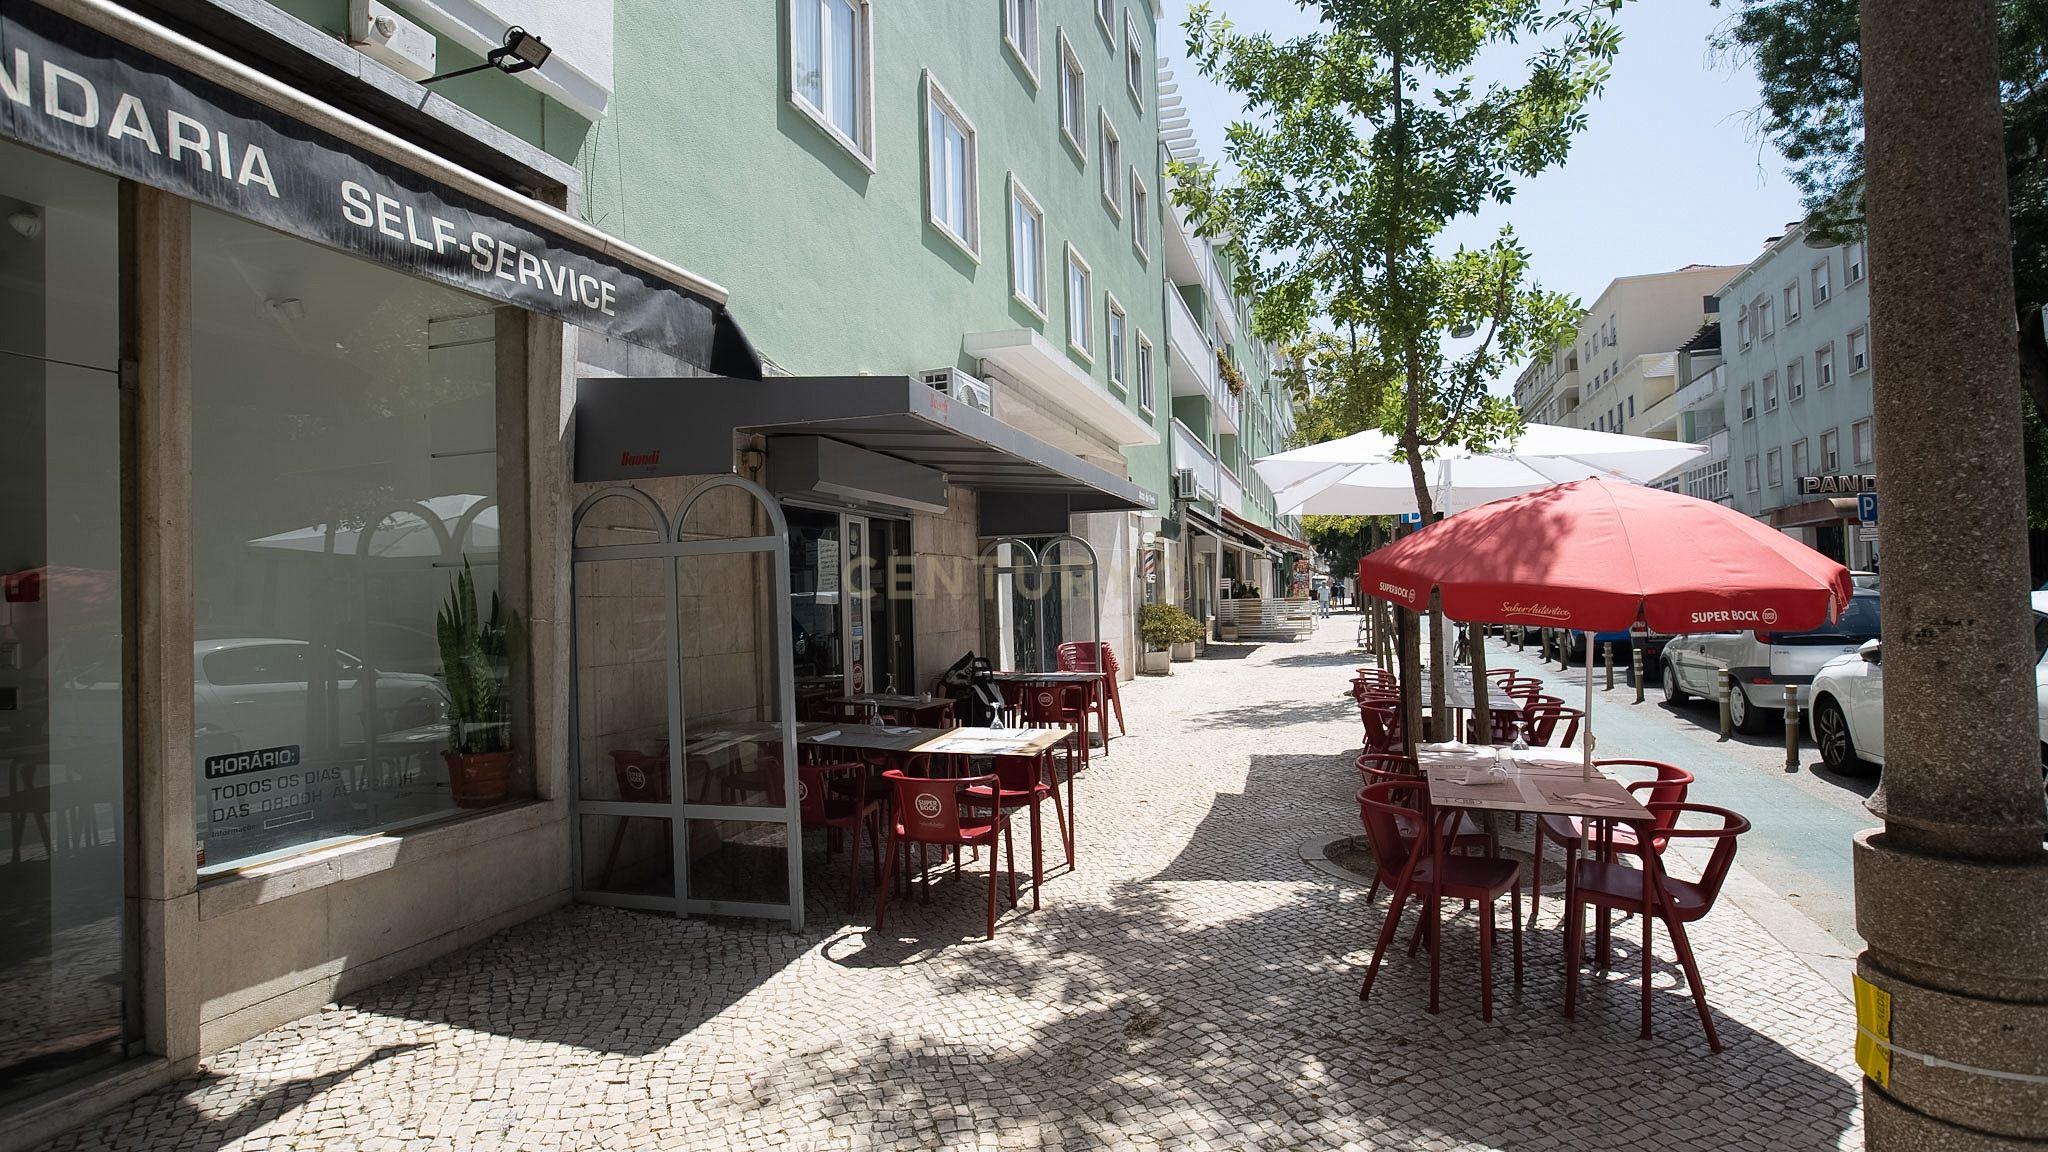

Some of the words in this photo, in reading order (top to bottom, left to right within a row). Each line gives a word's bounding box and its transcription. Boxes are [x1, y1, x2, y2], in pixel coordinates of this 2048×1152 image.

[341, 180, 617, 317] SELF-SERVICE
[1863, 496, 1874, 518] P
[1691, 610, 1730, 624] SUPER
[1731, 610, 1760, 621] BOCK
[210, 750, 296, 776] HORÁRIO:
[212, 779, 272, 801] TODOS
[277, 774, 299, 790] OS
[304, 766, 341, 785] DIAS
[212, 804, 250, 823] DAS
[261, 789, 322, 813] 08:00H
